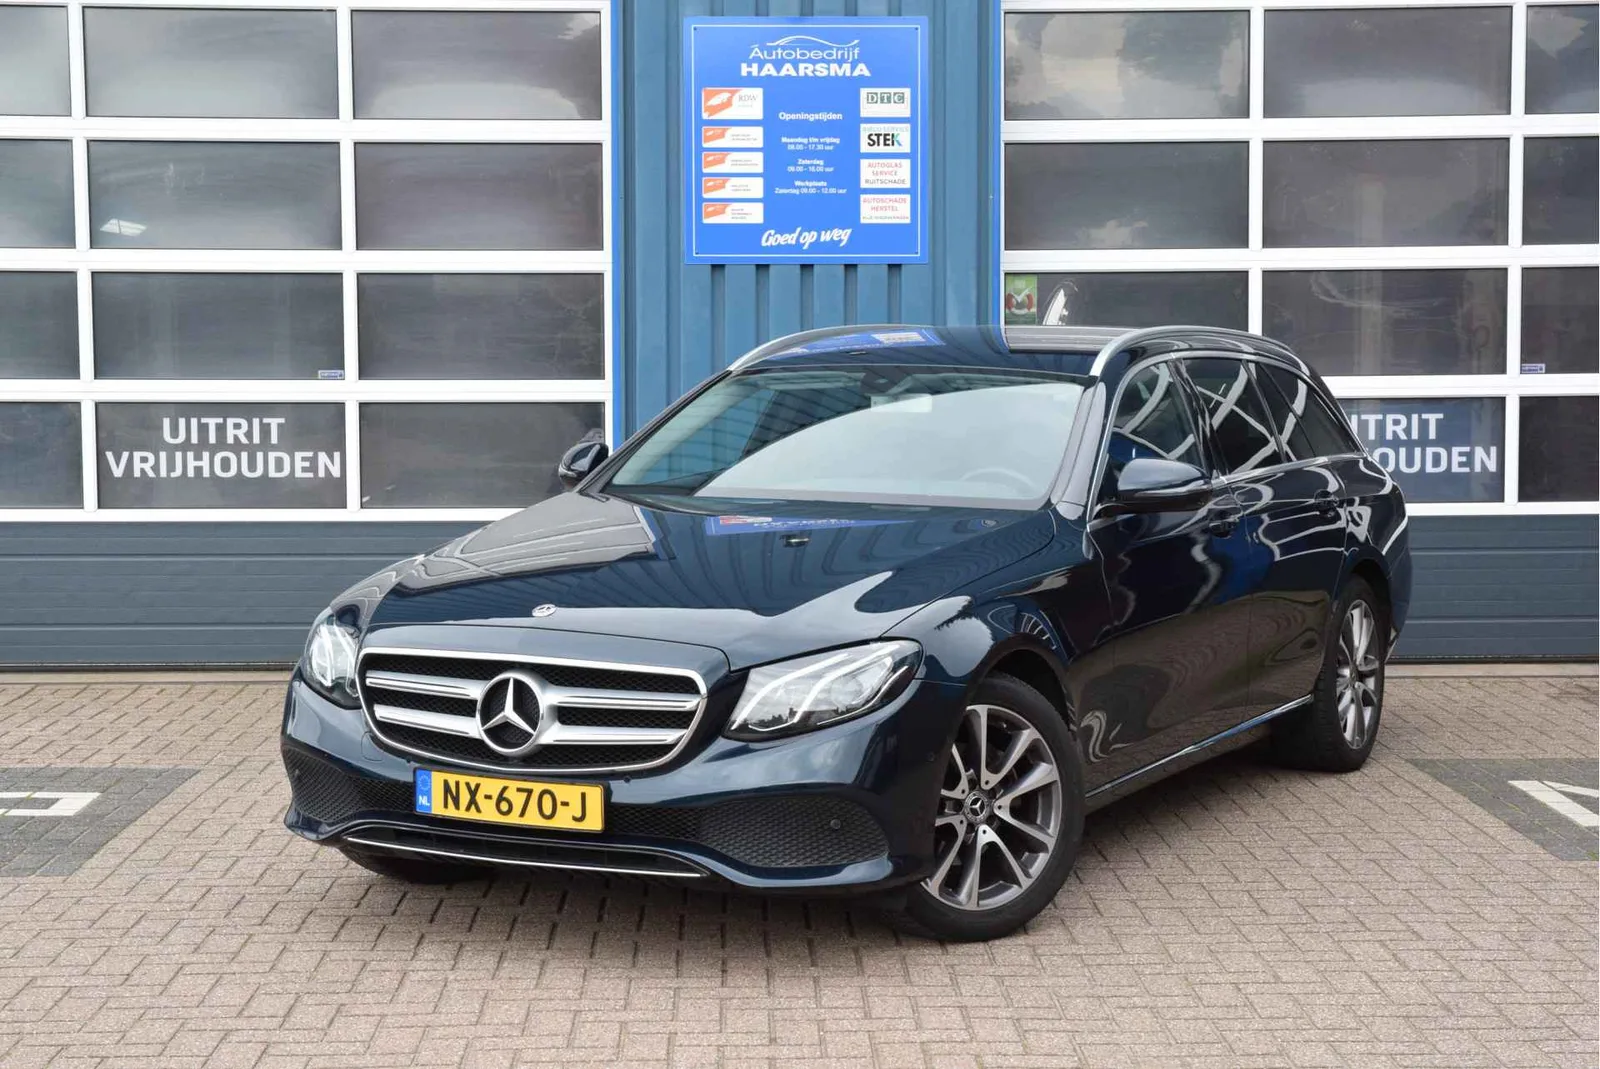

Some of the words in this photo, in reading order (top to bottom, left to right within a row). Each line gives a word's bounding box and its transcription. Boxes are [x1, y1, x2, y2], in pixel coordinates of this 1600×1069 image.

[748, 45, 860, 62] Autobedrijf
[740, 63, 872, 76] HAARSMA
[867, 92, 905, 104] DTC
[778, 111, 843, 121] Openingstijden
[781, 136, 808, 144] Maandag
[820, 137, 841, 145] vrijdag
[867, 133, 903, 147] STEK
[761, 227, 802, 247] Goed
[800, 231, 818, 250] op
[820, 228, 852, 247] weg
[162, 417, 286, 444] UITRIT
[1350, 413, 1444, 440] ITRIT
[105, 451, 341, 478] VRIJHOUDEN
[1371, 446, 1497, 473] OUDEN
[418, 795, 430, 806] NL
[442, 779, 587, 823] NX-670-J
